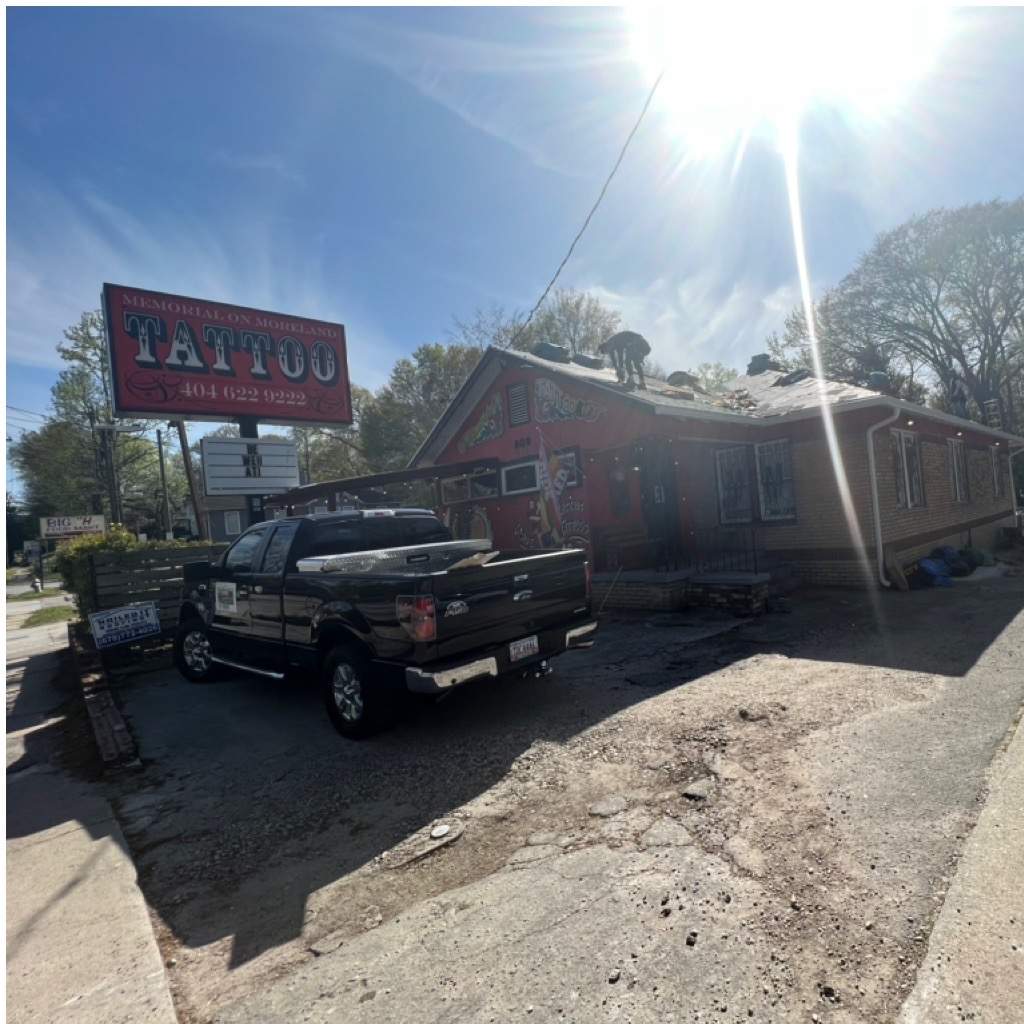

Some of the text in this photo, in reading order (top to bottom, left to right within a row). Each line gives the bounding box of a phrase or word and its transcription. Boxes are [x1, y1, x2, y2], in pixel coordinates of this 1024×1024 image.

[121, 293, 337, 338] MEMORIAL ON MORELAND
[123, 311, 337, 383] TATTOO
[180, 382, 219, 399] 404
[223, 386, 259, 402] 622
